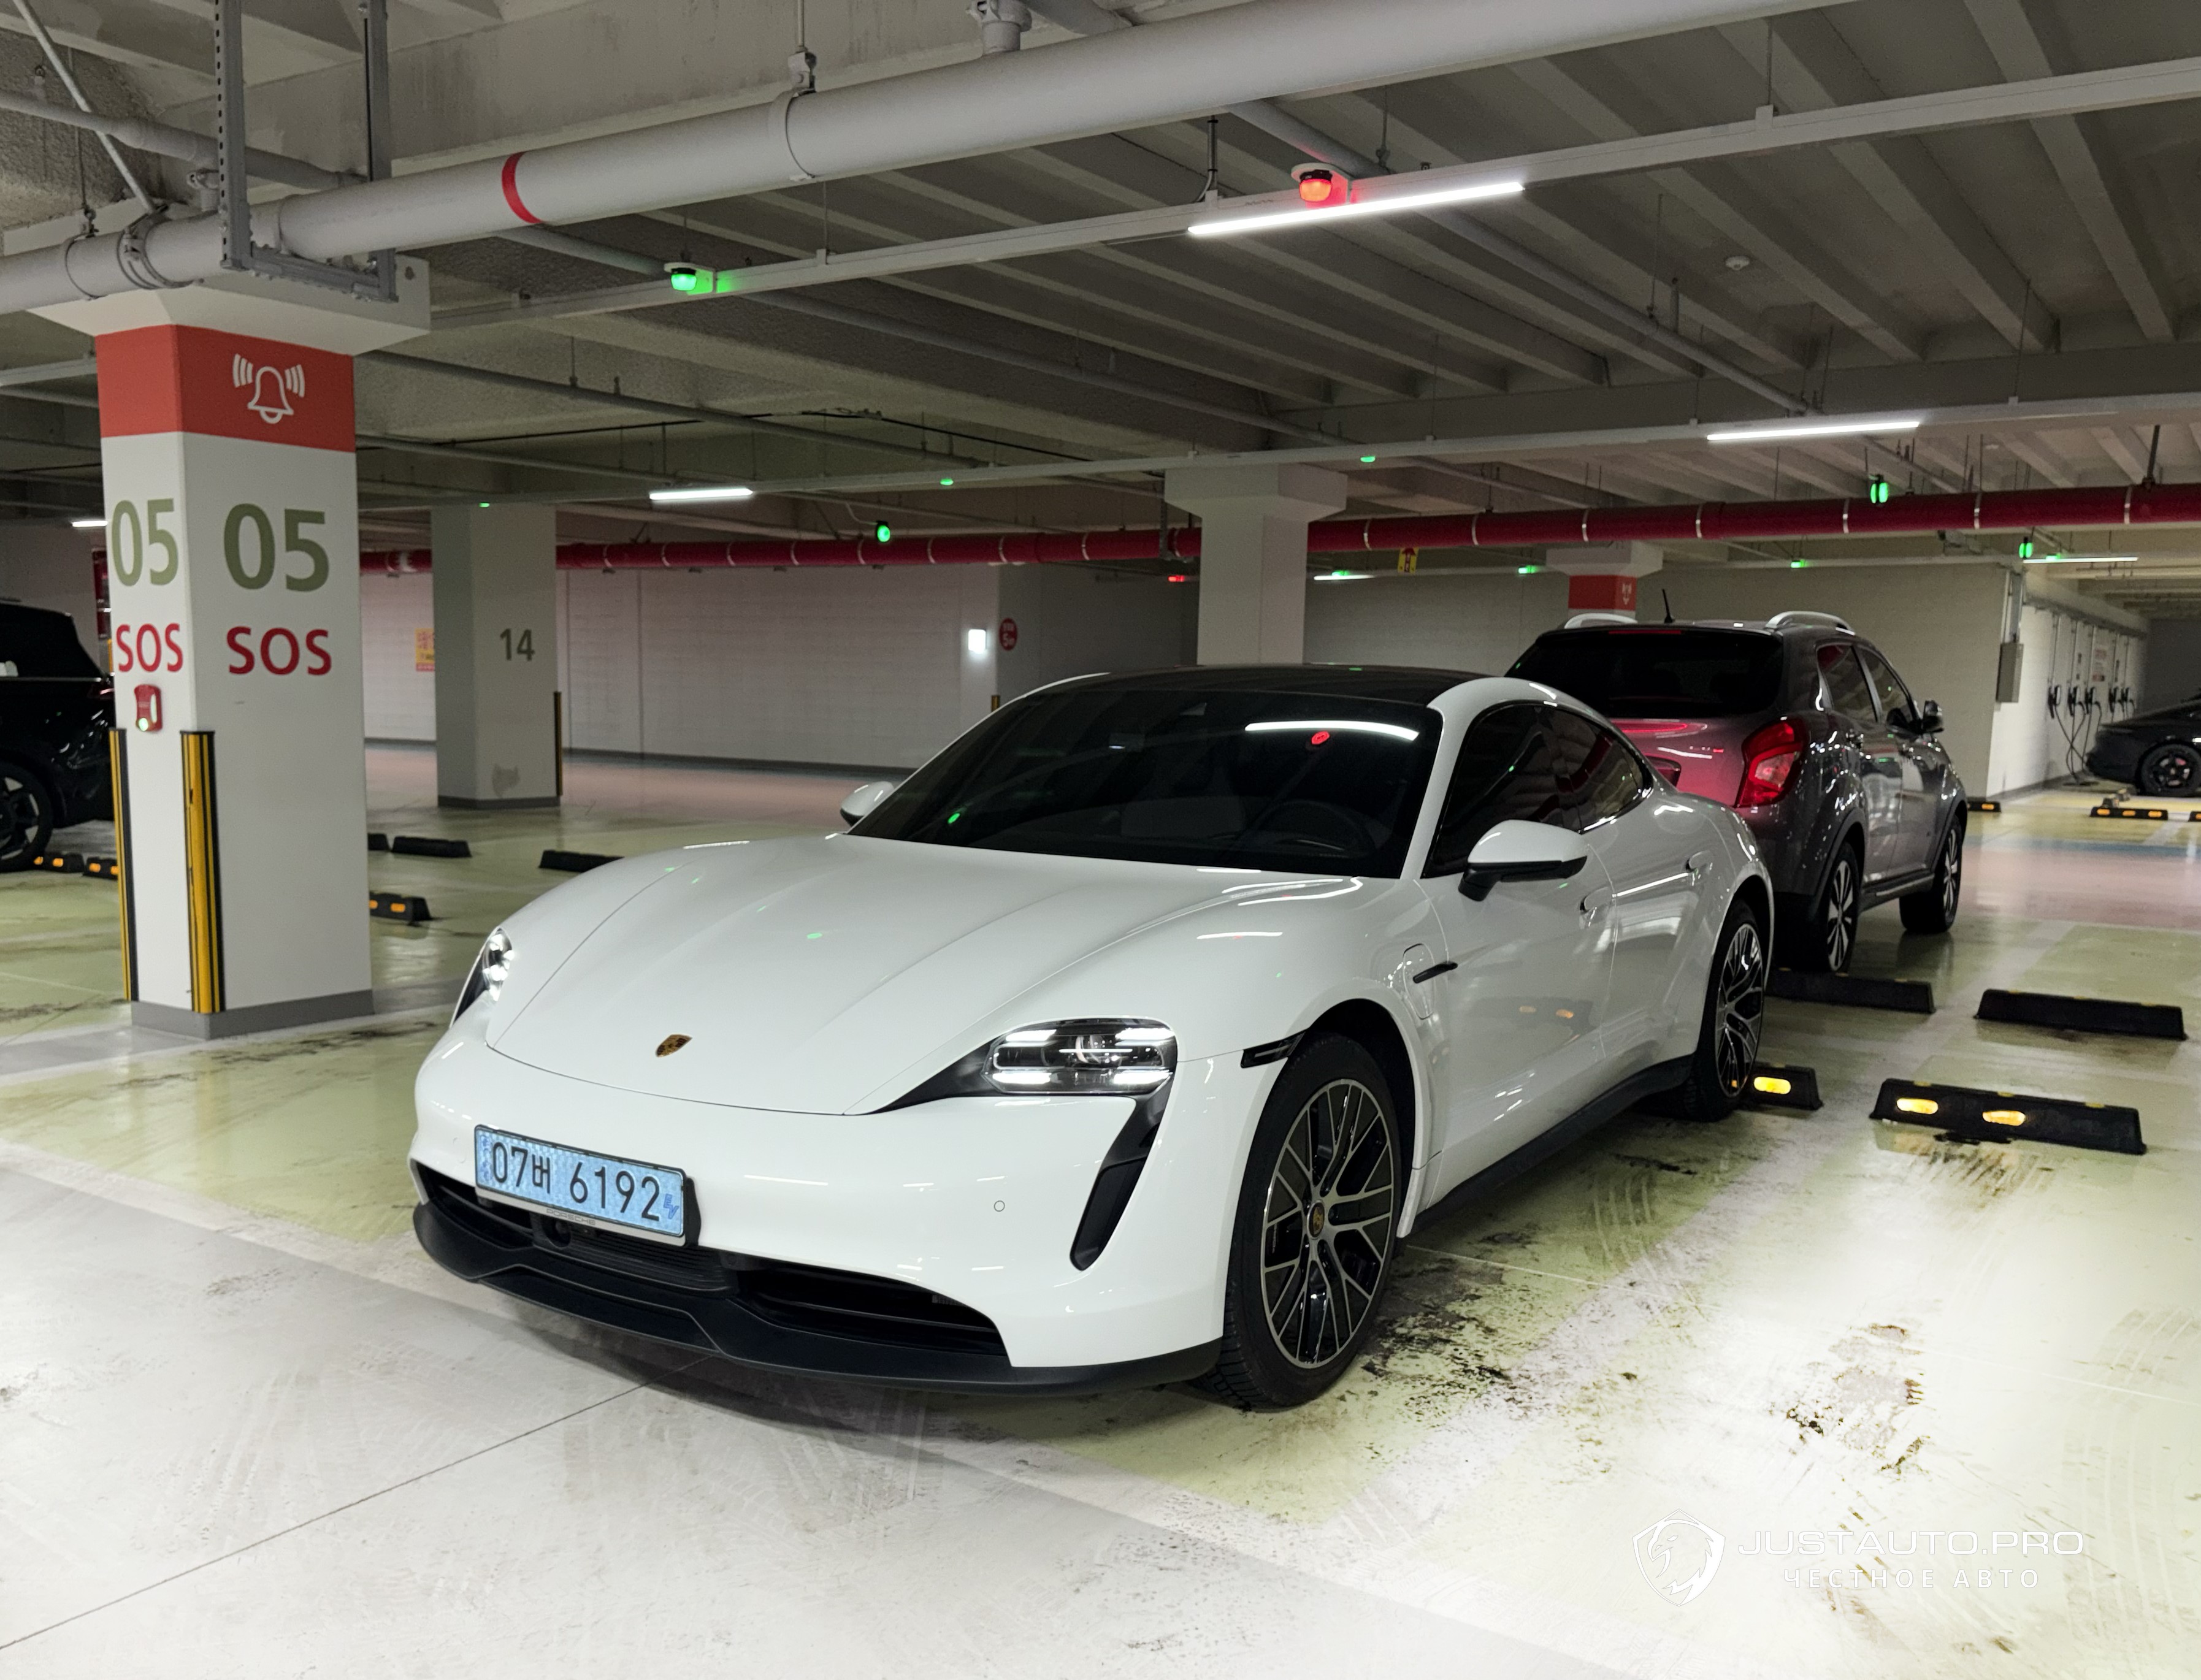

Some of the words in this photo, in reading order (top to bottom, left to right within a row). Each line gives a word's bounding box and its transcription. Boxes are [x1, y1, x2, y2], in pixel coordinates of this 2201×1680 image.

[112, 498, 179, 587] 05
[223, 503, 330, 592] 05
[115, 623, 183, 673] SOS
[226, 626, 332, 676] SOS
[500, 628, 535, 662] 14
[492, 1142, 551, 1194] 07버
[570, 1161, 660, 1221] 6192
[663, 1193, 679, 1220] EV
[546, 1208, 596, 1226] PORSCHE
